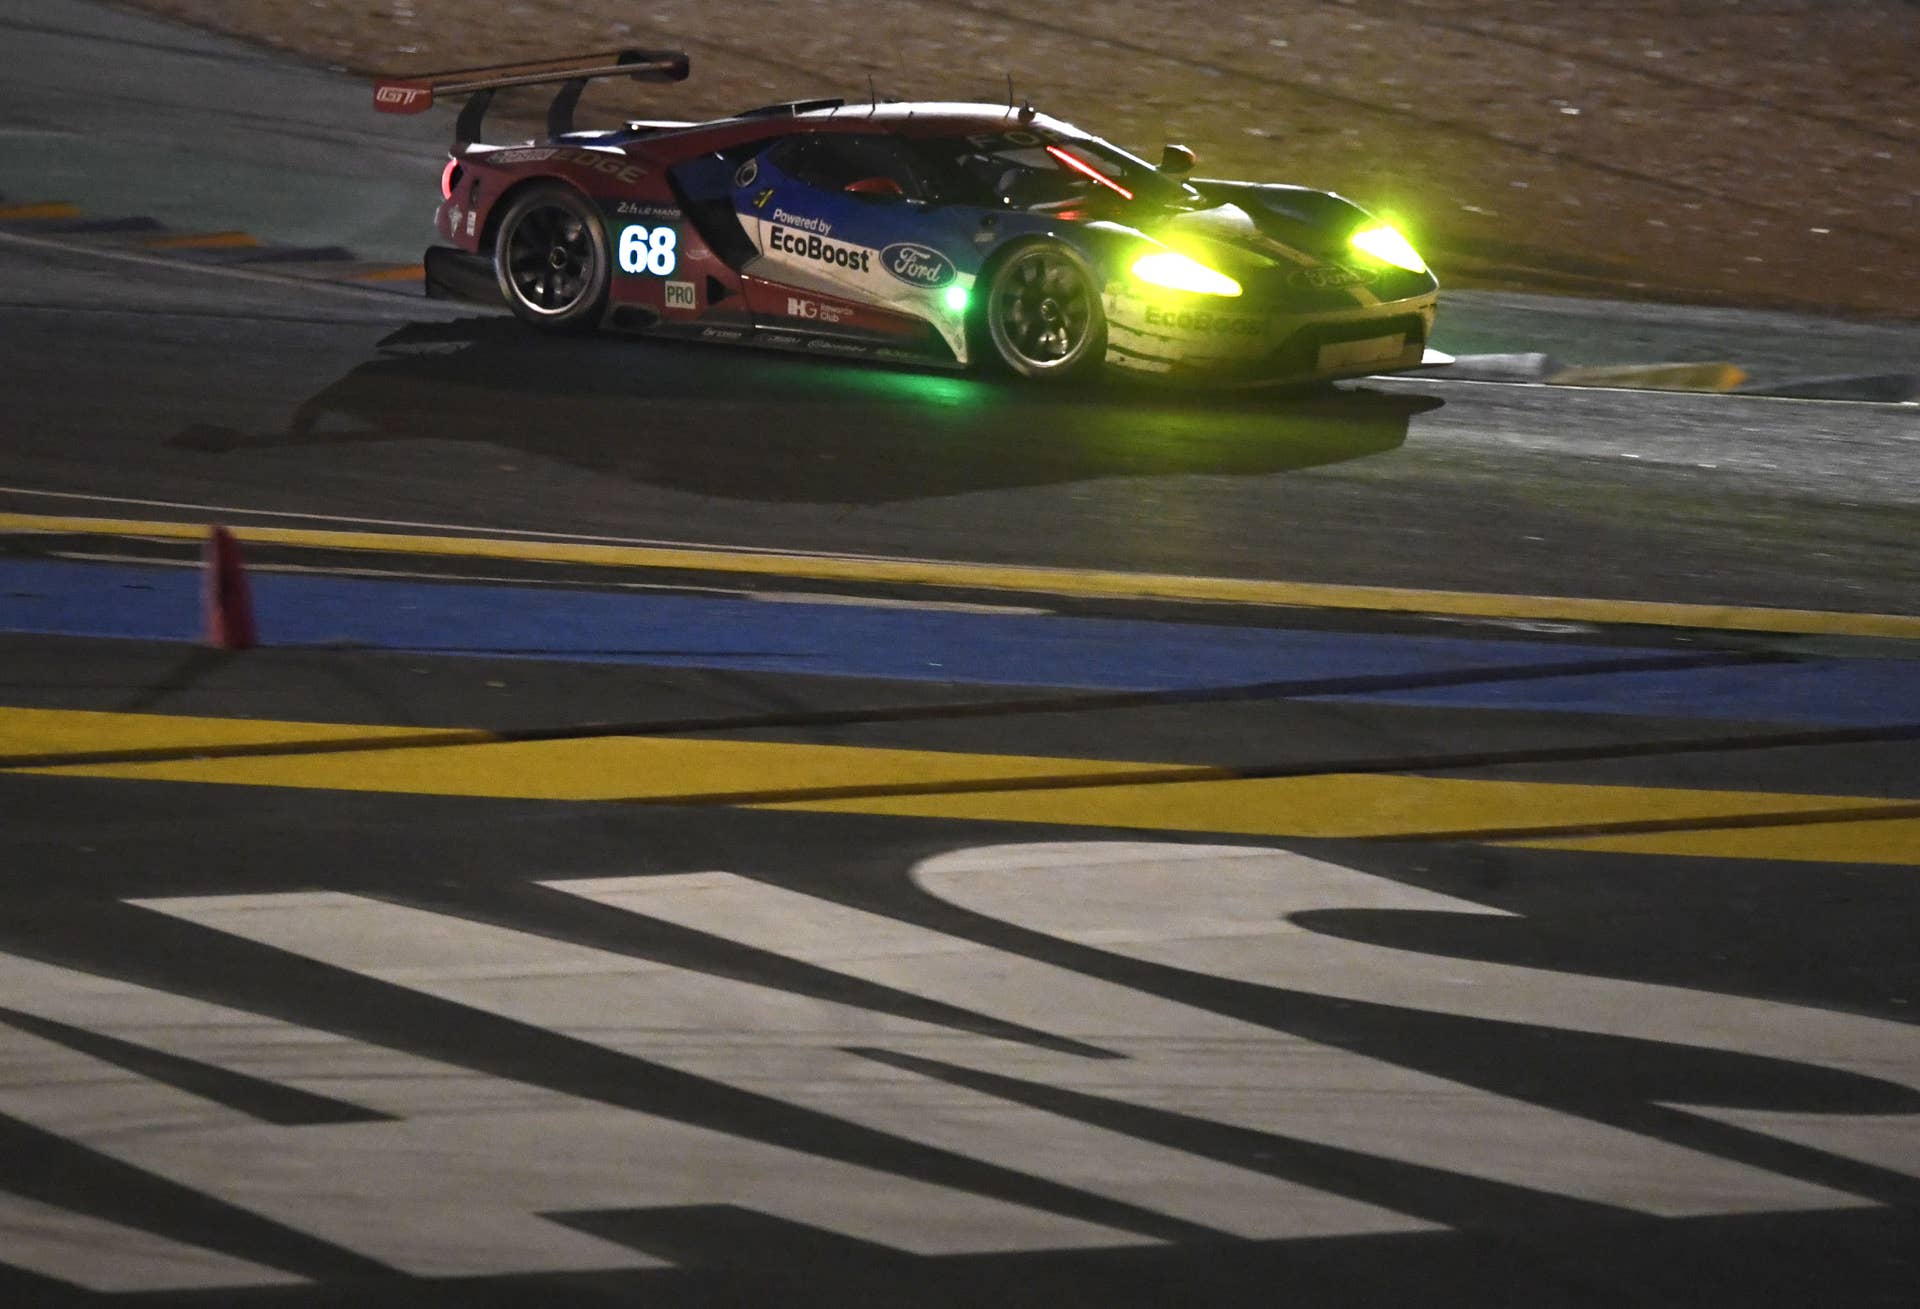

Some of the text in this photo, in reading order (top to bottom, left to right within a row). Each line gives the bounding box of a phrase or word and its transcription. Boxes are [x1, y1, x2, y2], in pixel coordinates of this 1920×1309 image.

[773, 208, 833, 236] Powered by
[618, 224, 677, 276] 68
[770, 225, 870, 273] EcoBoost
[893, 247, 942, 282] Ford
[666, 285, 694, 305] PRO
[787, 296, 817, 319] IHG
